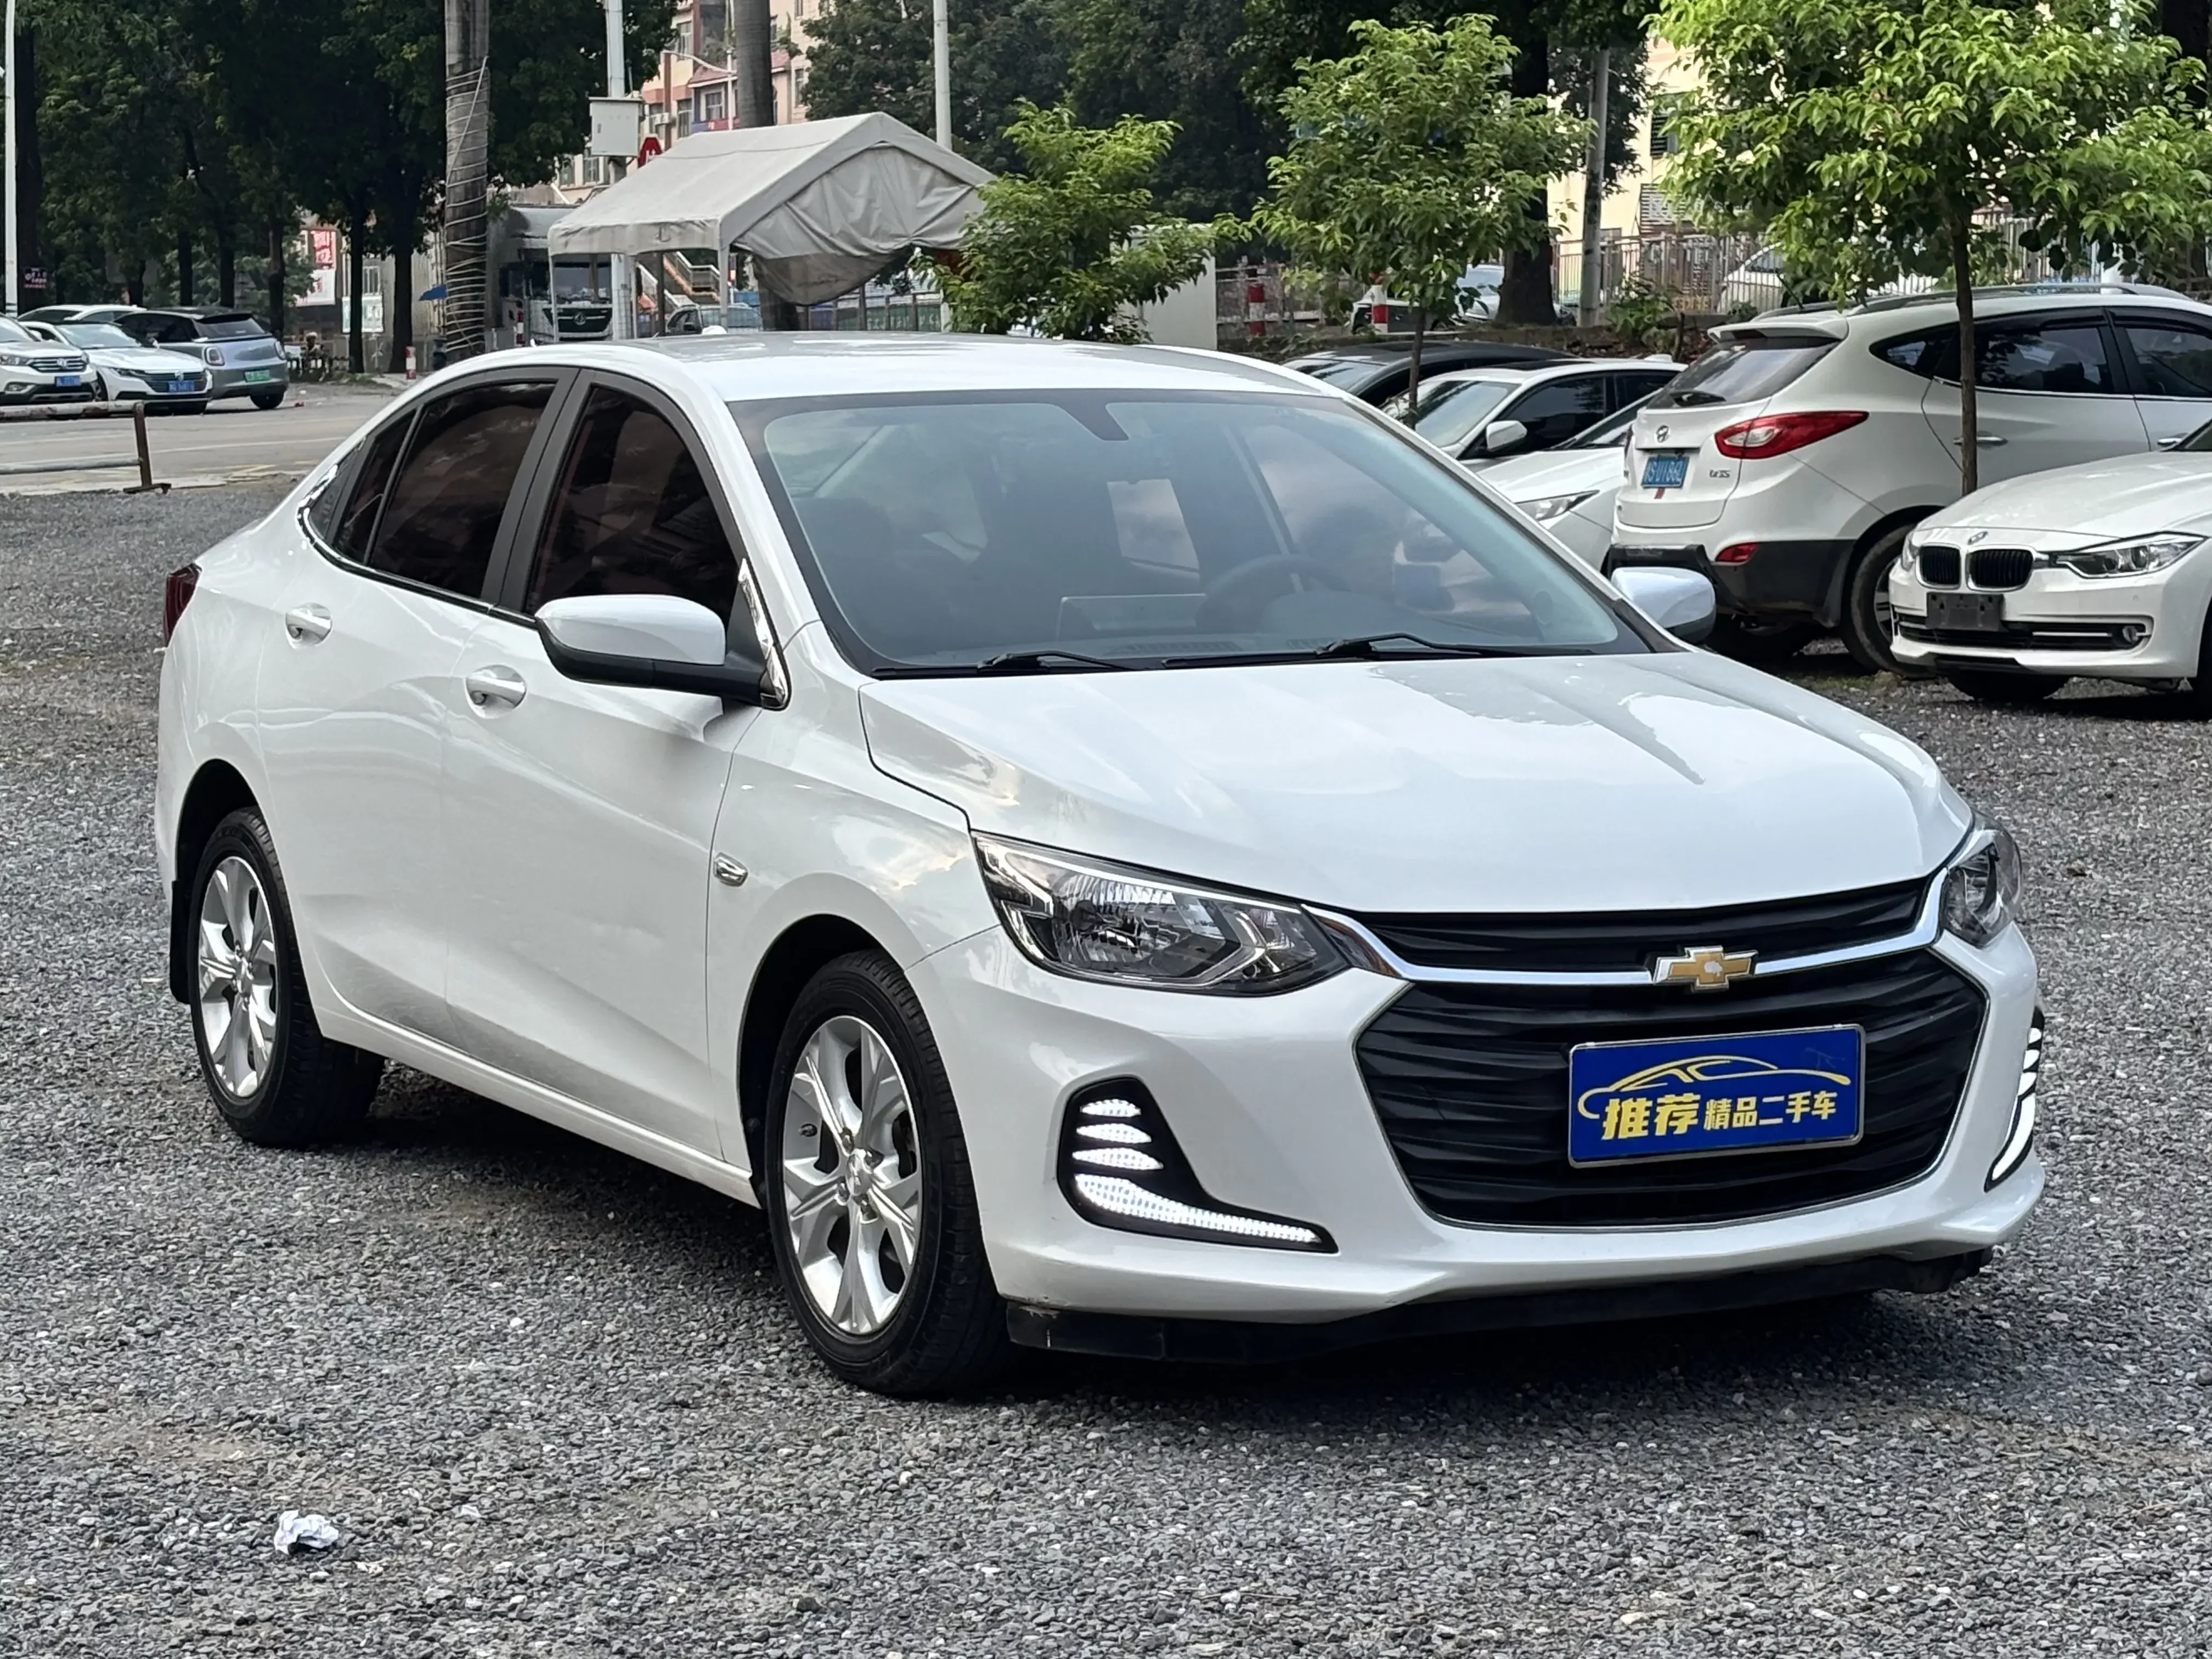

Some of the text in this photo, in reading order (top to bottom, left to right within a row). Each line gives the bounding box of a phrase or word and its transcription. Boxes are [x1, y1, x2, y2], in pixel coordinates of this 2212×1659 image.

[1601, 1090, 1838, 1140] 推荐 精品二手车
